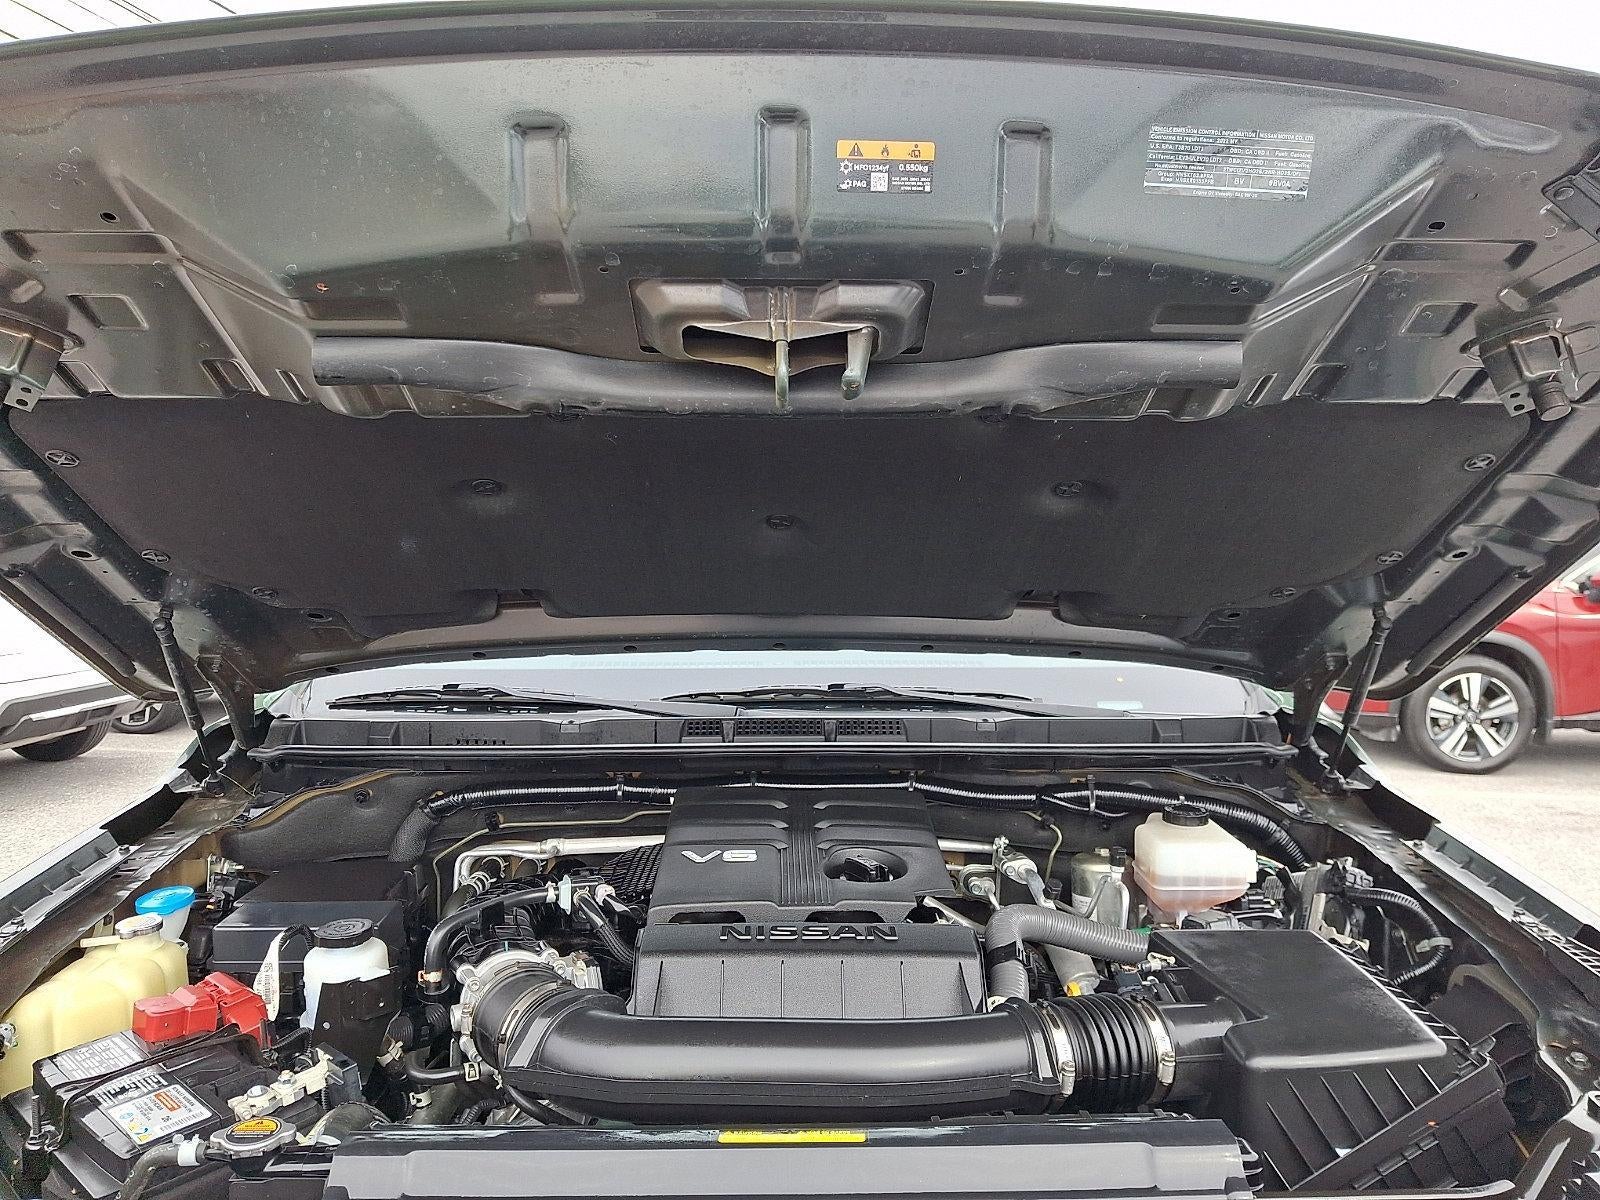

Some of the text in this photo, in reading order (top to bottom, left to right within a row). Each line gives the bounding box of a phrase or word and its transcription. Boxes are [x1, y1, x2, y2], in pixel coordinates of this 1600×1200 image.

[854, 164, 928, 172] HFO1234yf 0.550kg
[681, 849, 758, 863] V6
[719, 925, 899, 941] NISSAN
